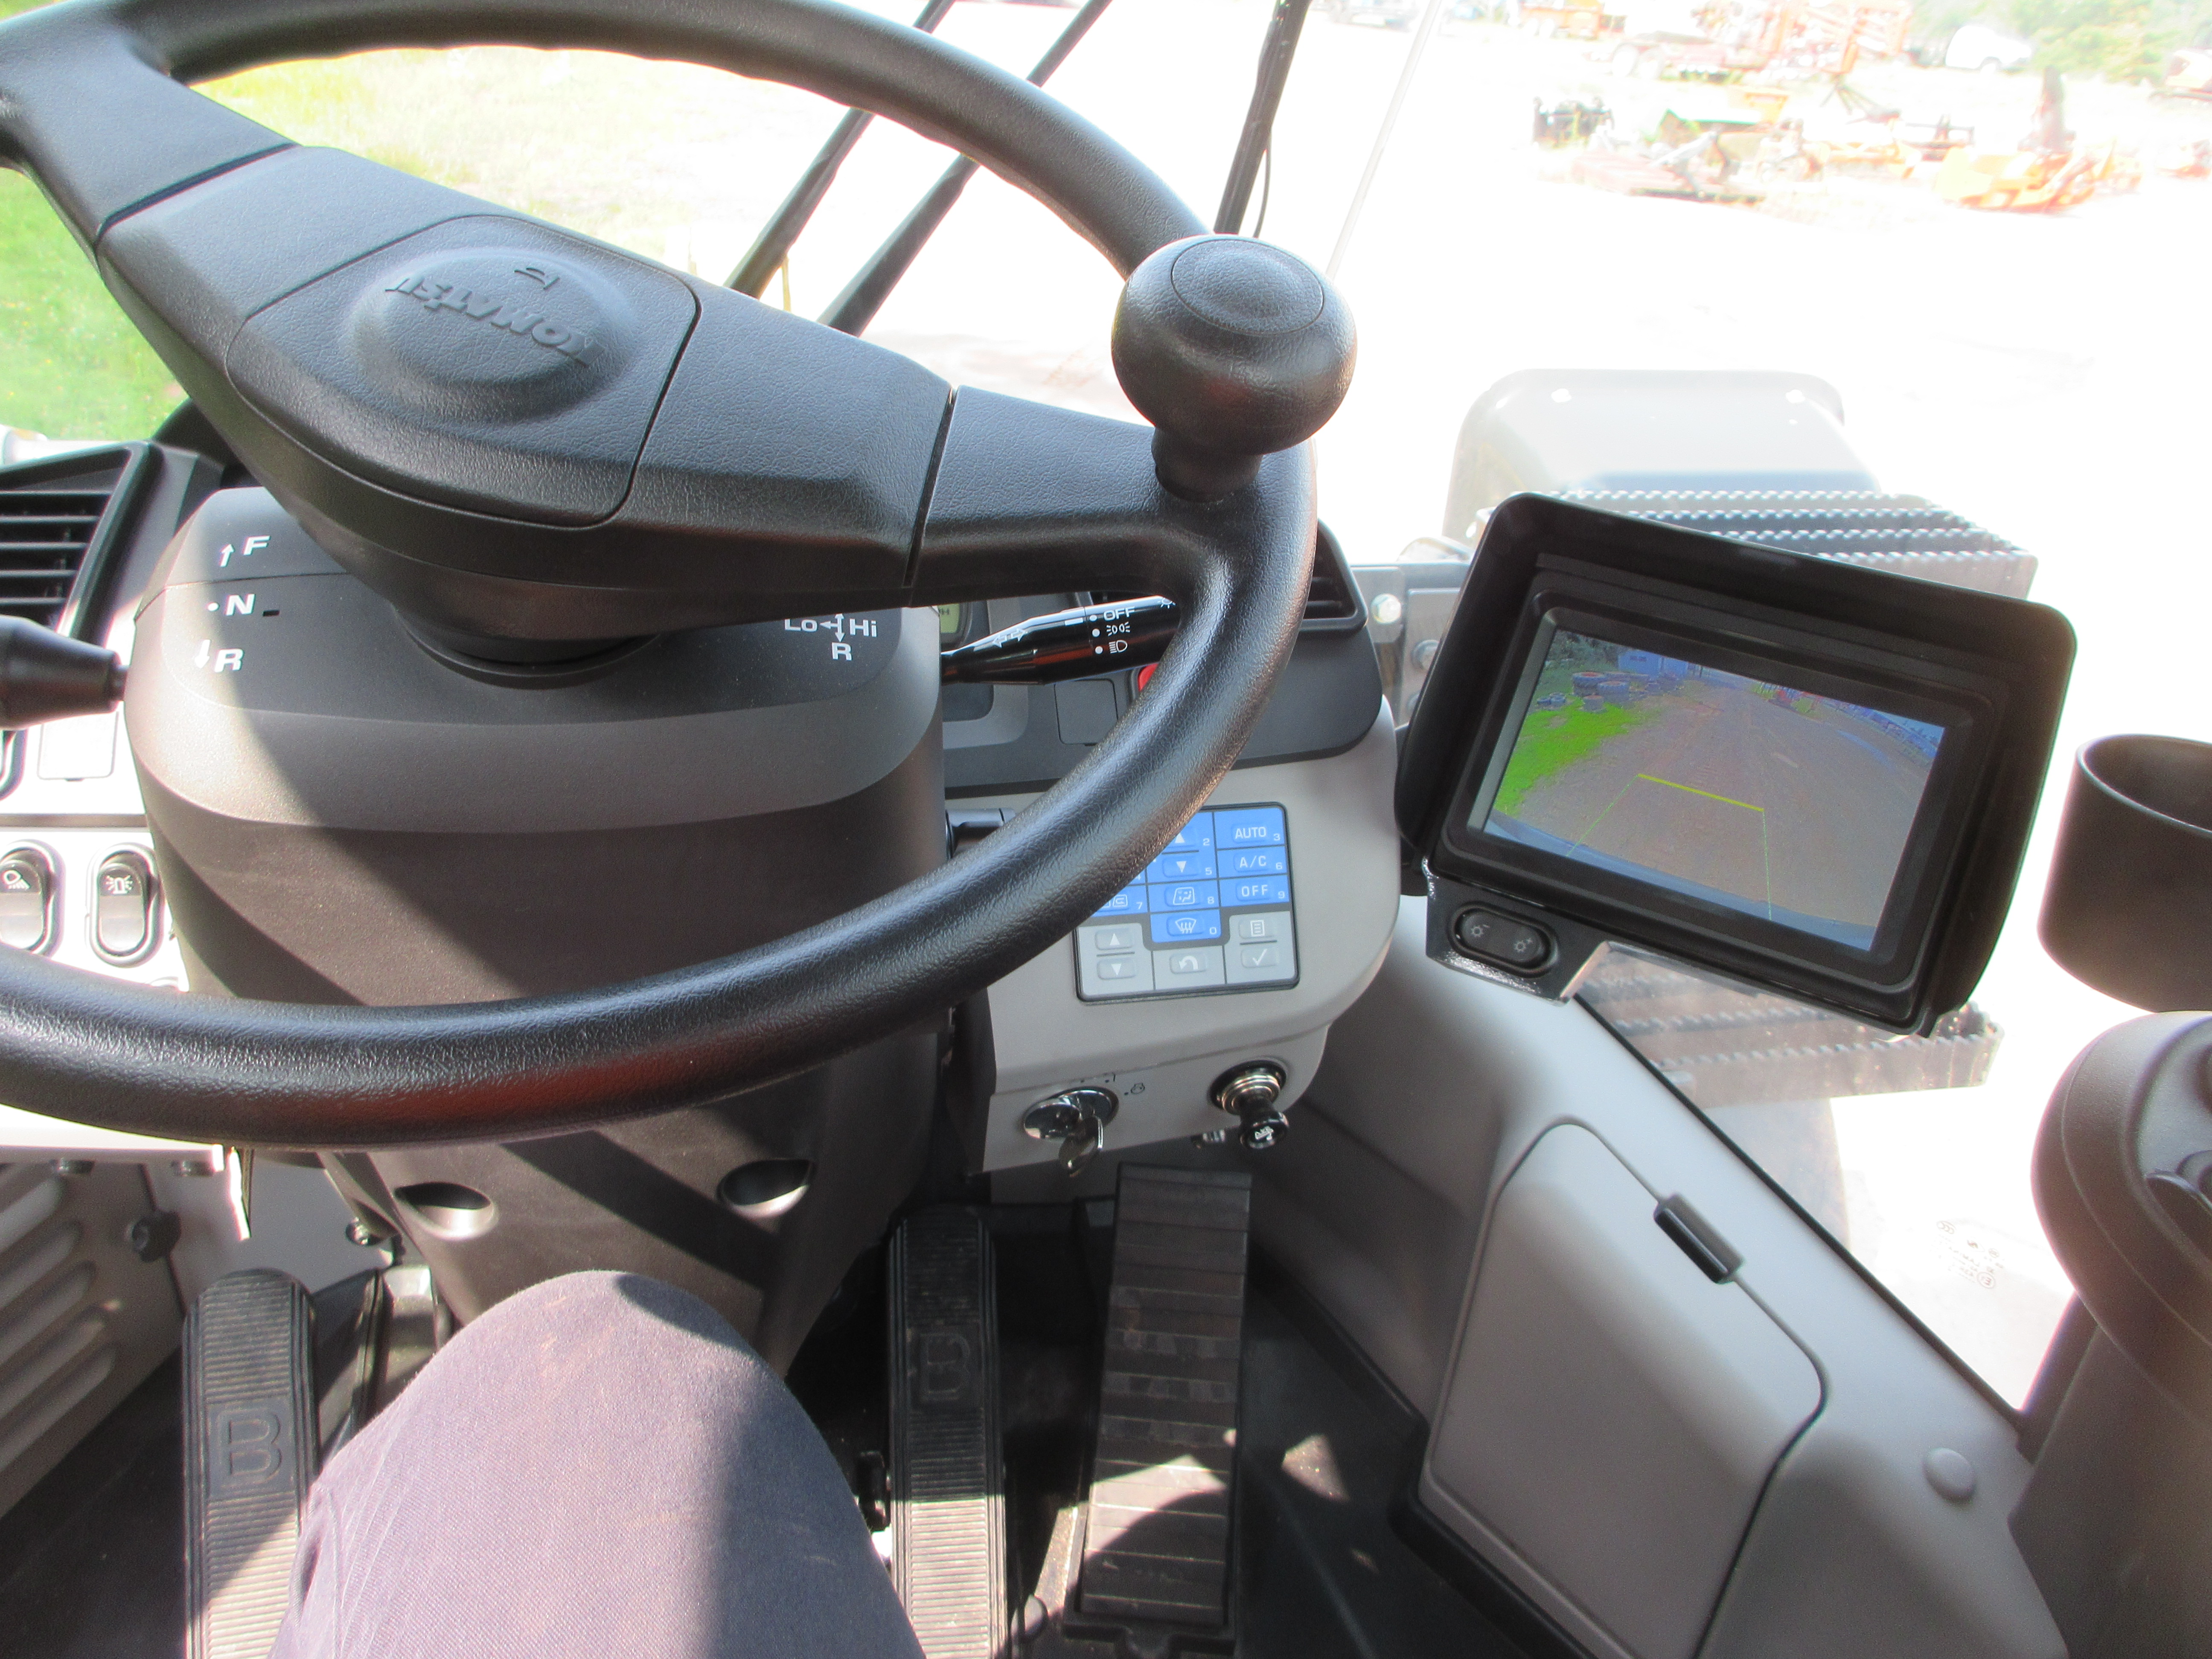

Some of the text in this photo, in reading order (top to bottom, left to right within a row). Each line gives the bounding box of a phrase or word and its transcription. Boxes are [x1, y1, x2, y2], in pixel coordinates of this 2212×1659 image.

[243, 535, 271, 555] F
[225, 594, 256, 616] N
[1103, 606, 1135, 621] OFF
[784, 618, 818, 632] Lo
[850, 618, 877, 637] Hi
[832, 642, 853, 661] R
[215, 648, 244, 673] R
[1235, 827, 1266, 839] AUTO
[1239, 856, 1267, 868] A/C
[1205, 867, 1212, 875] 5
[1241, 885, 1268, 897] OFF
[1136, 901, 1143, 909] 7
[919, 1332, 971, 1403] B
[218, 1407, 282, 1488] B
